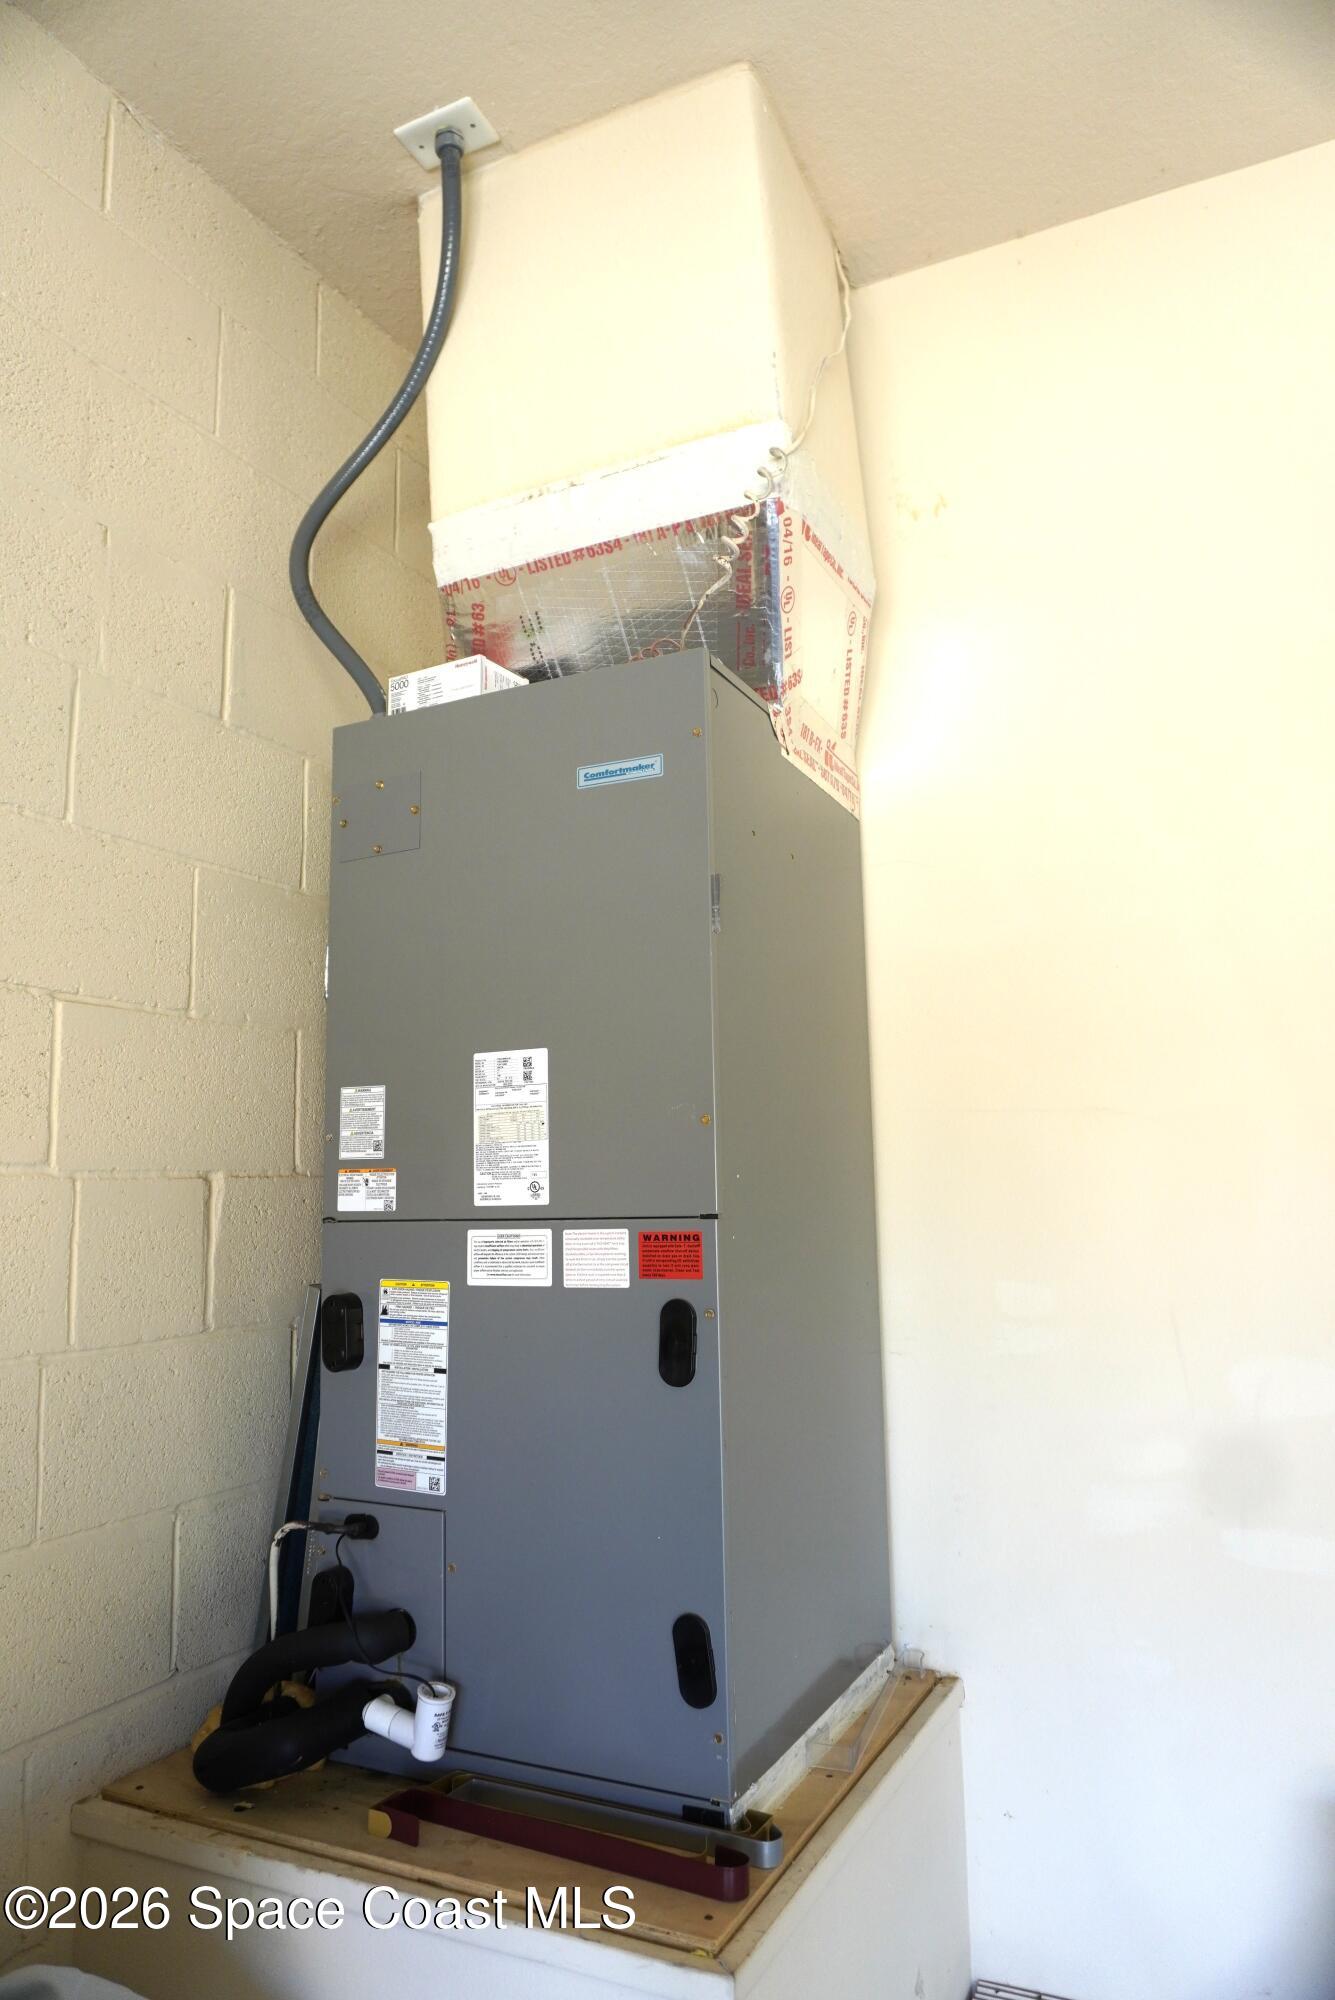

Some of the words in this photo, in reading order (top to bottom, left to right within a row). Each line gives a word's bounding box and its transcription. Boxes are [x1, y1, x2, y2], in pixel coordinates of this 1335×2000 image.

[782, 517, 794, 567] 04/16
[390, 678, 410, 692] 5000
[583, 762, 656, 779] Comfortmaker
[642, 1233, 700, 1242] WARNING
